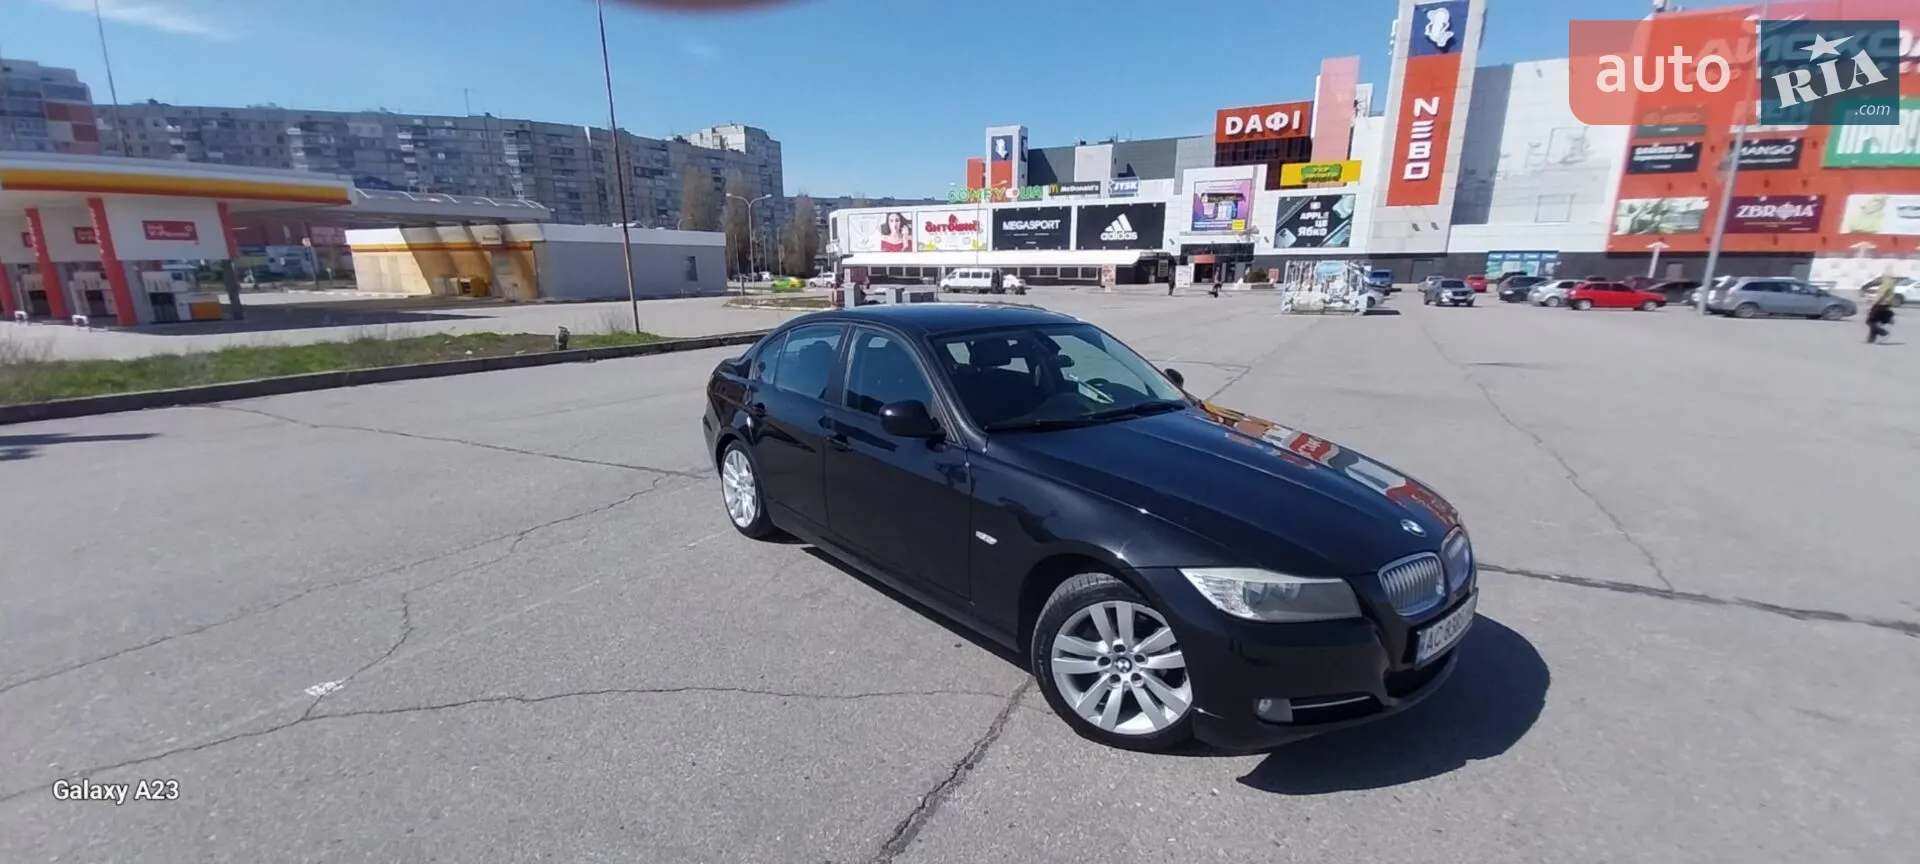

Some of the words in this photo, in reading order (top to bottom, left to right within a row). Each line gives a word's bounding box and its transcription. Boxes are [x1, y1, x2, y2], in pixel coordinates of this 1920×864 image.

[1403, 96, 1440, 180] NEBO
[1060, 184, 1100, 193] McDonald's
[1113, 181, 1137, 191] JYSK
[1299, 211, 1330, 220] APPLE
[1002, 219, 1062, 231] MEGASPORT
[1100, 231, 1138, 241] adidas
